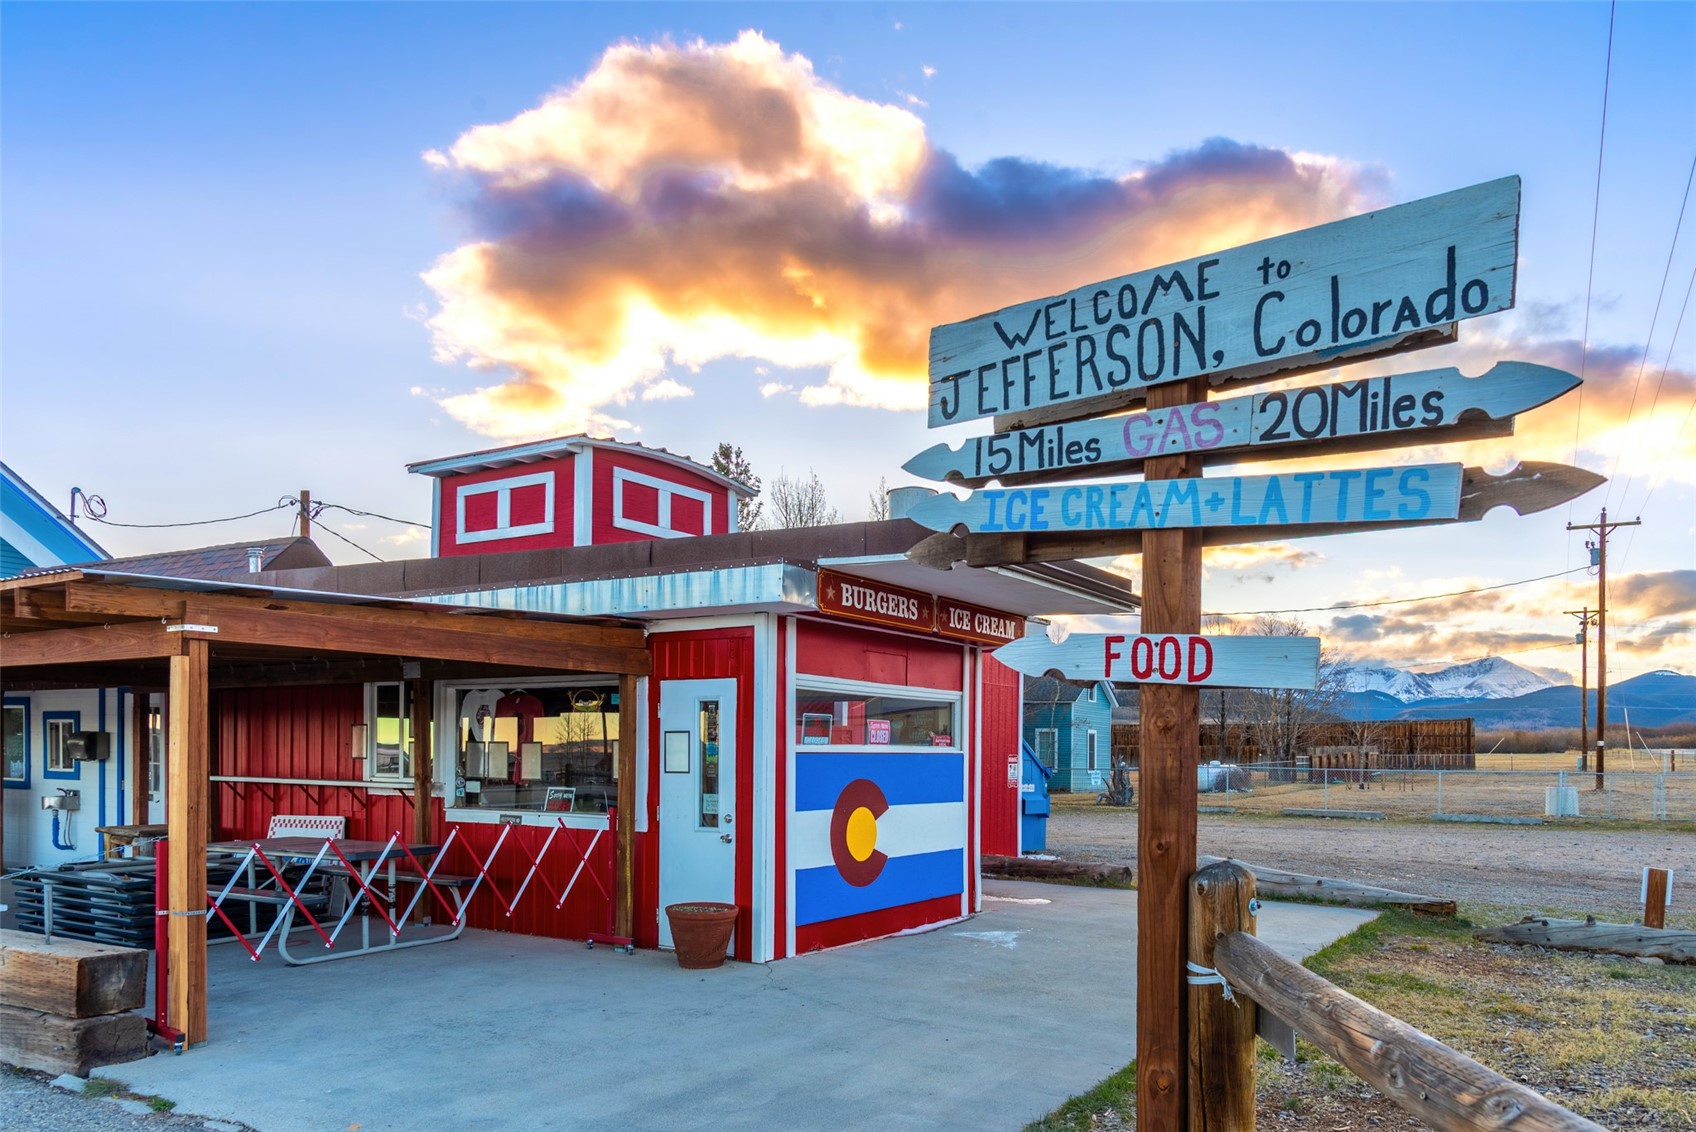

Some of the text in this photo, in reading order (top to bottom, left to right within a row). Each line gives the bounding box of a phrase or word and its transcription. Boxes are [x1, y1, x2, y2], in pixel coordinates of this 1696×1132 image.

[994, 256, 1292, 349] WELCOME to
[940, 245, 1489, 418] JEFFERSON, Colorado
[1123, 401, 1225, 457] GAS
[979, 488, 1049, 532] ICE
[840, 583, 919, 621] BURGERS
[949, 607, 1016, 640] ICE CREAM
[1104, 635, 1214, 683] FOOD
